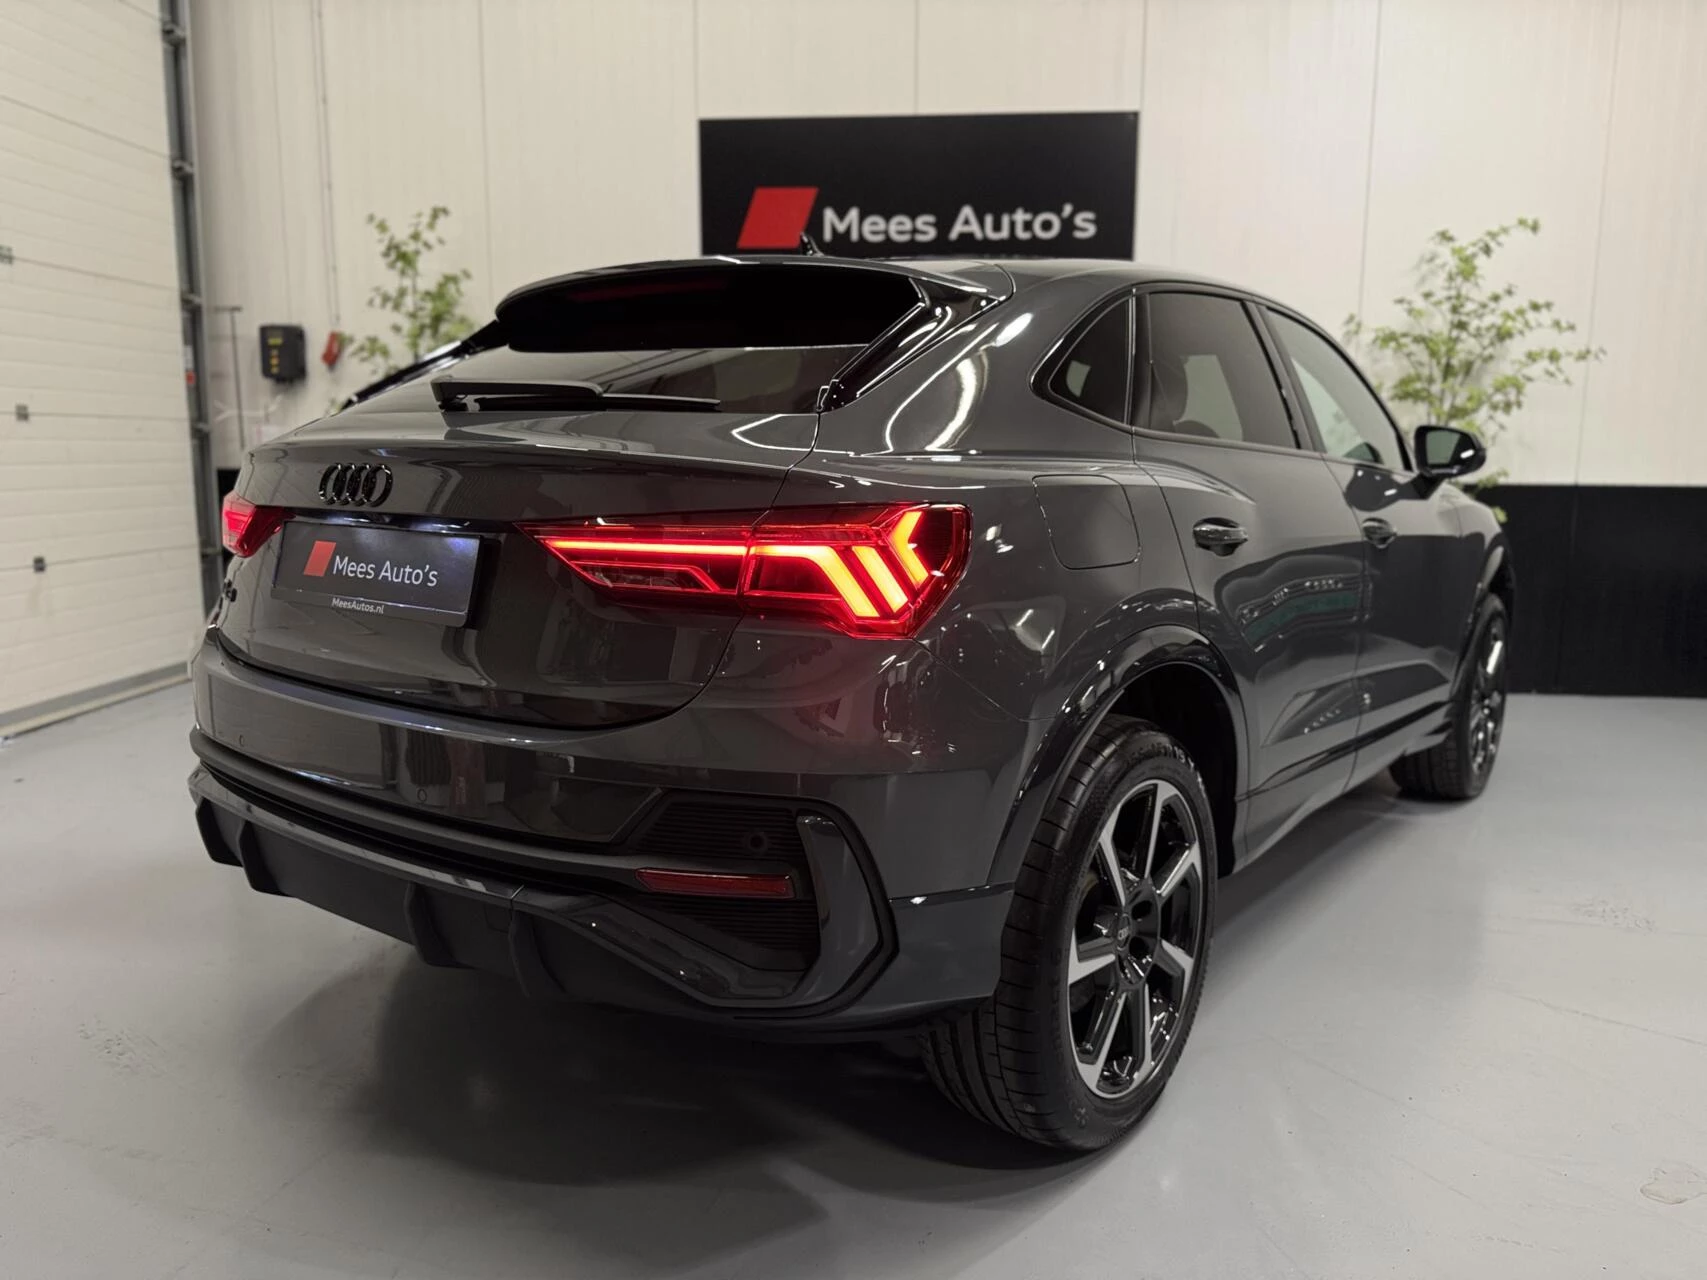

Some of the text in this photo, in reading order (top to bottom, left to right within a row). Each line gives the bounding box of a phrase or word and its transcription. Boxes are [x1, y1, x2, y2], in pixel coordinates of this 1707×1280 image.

[823, 203, 1097, 243] Mees Auto's
[332, 555, 438, 587] Mees Auto's
[331, 597, 385, 614] MeesAutos.nl
